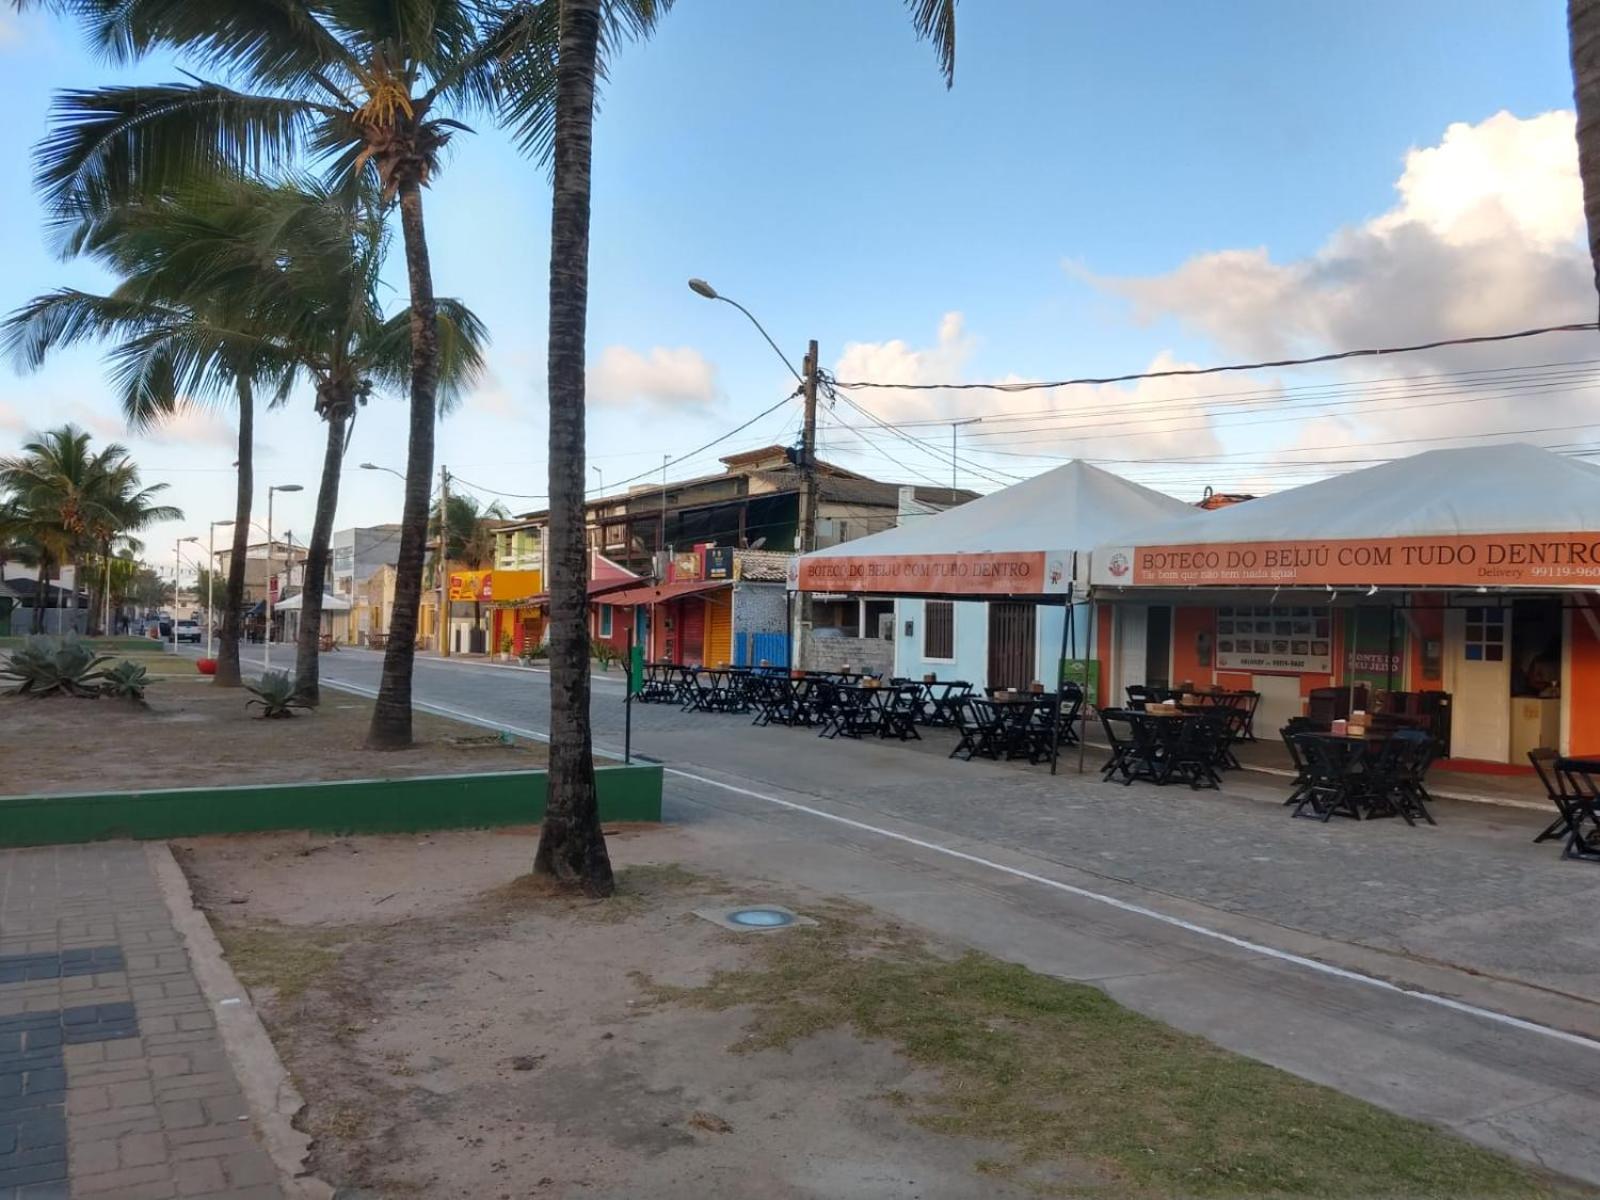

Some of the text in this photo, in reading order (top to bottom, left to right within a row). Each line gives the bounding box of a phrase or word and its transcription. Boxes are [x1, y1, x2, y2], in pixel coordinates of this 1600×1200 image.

[1142, 542, 1600, 569] BOTECO DO BEIJÚ COM TUDO DENTRO
[849, 563, 865, 577] DO
[904, 563, 929, 577] COM
[973, 562, 1030, 577] DENTRO
[1478, 567, 1523, 580] Delivery
